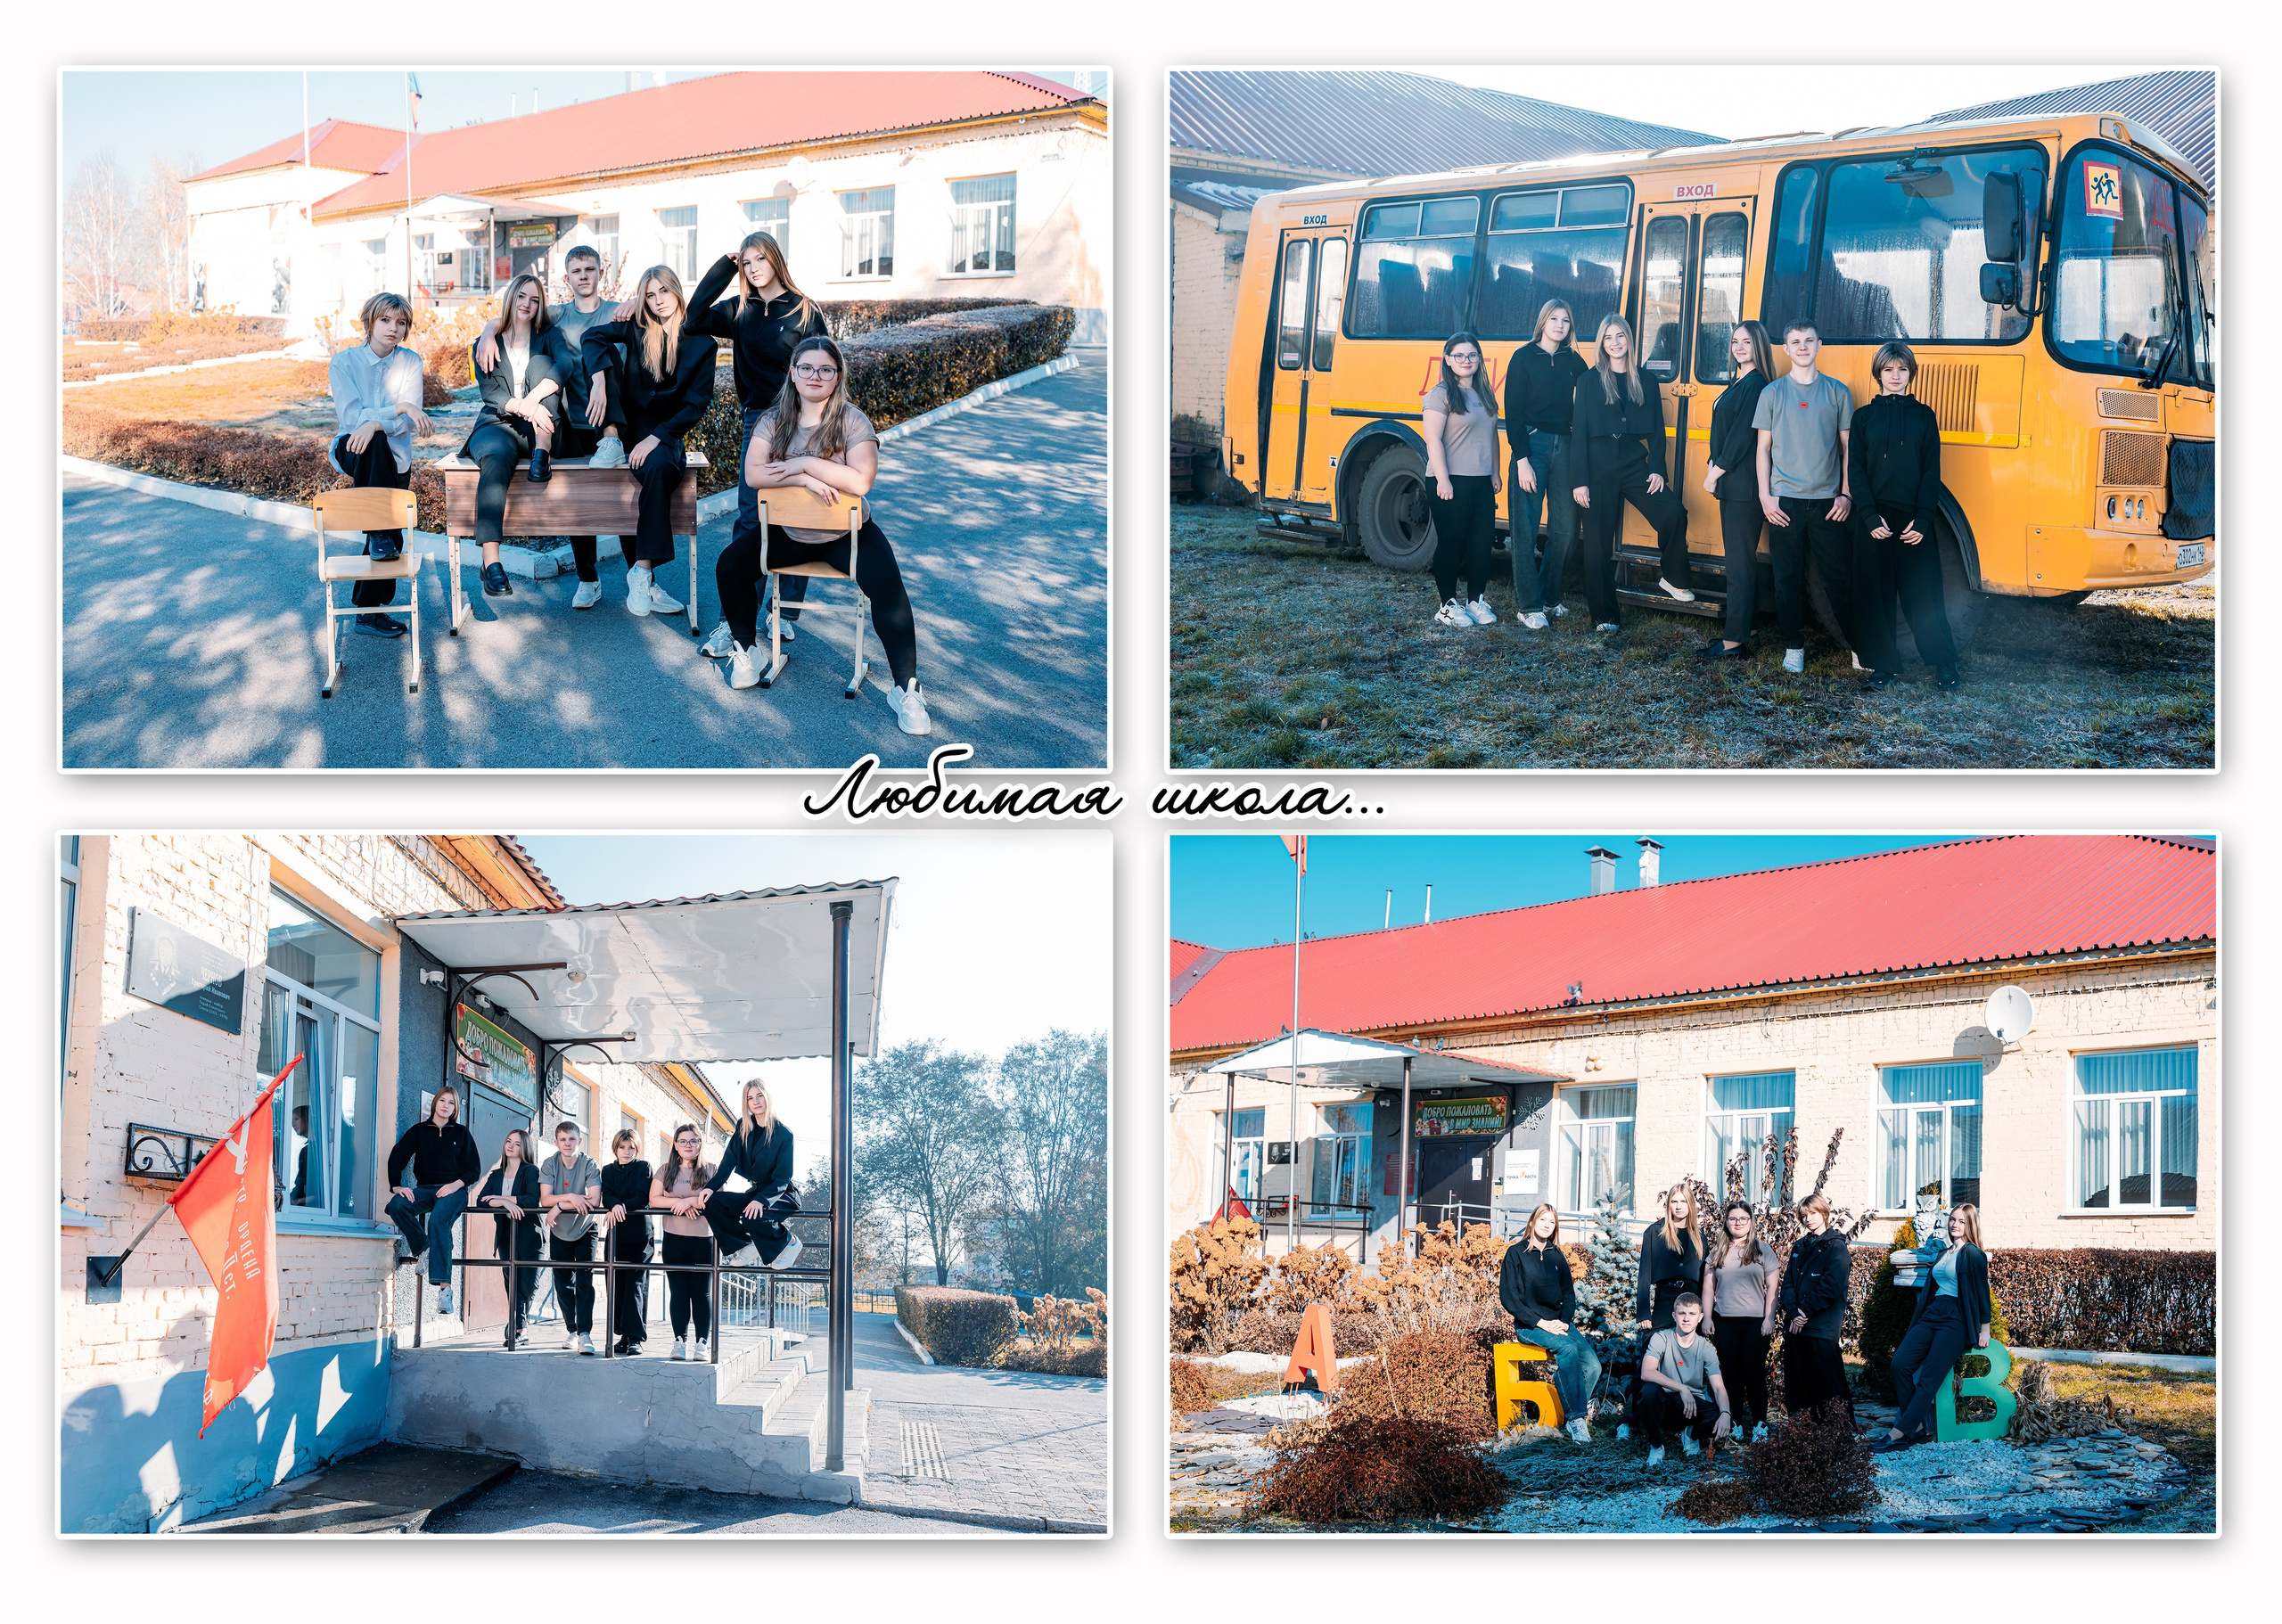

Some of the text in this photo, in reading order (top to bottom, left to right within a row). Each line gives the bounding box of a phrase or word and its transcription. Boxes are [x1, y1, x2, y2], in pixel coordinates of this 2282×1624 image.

[1676, 184, 1714, 197] ВХОД
[1303, 214, 1327, 226] ВХОД
[201, 966, 223, 988] ЧЕРНОВ
[464, 1020, 527, 1074] ДОБРО ПОЖАЛОВАТЬ
[1422, 1103, 1492, 1120] ДОБРО ПОЖАЛОВАТЬ
[1449, 1116, 1503, 1130] В МИР ЗНАНИЙ!
[237, 1220, 261, 1281] ОРДЕНА
[1284, 1303, 1338, 1394] А
[1493, 1342, 1564, 1431] Б
[1934, 1337, 2018, 1442] В
